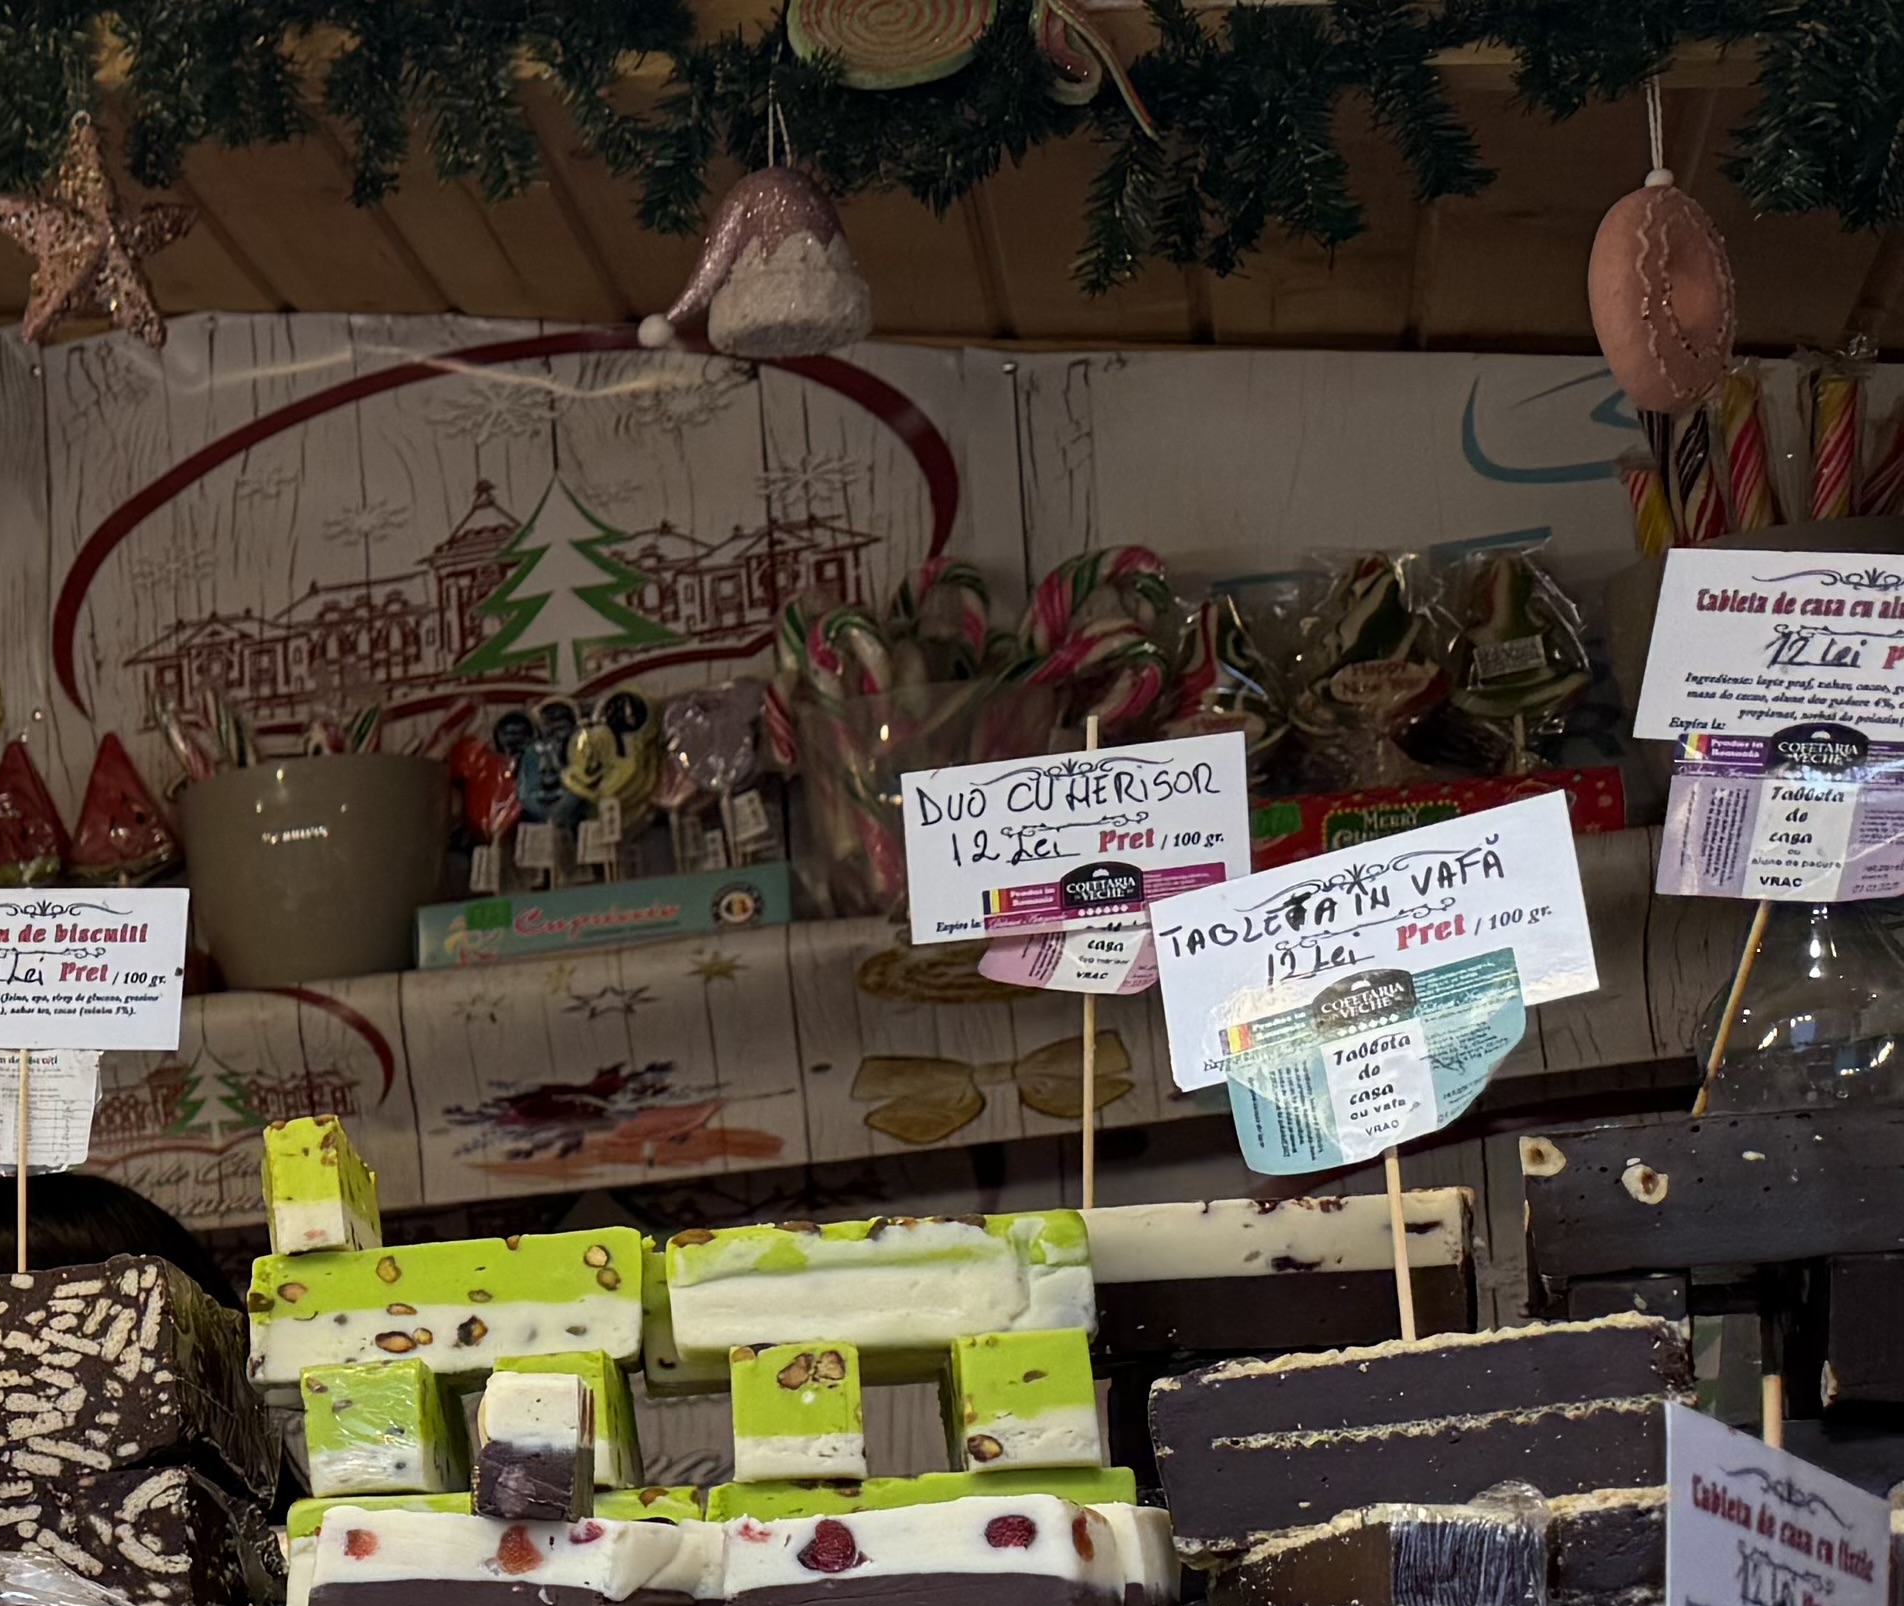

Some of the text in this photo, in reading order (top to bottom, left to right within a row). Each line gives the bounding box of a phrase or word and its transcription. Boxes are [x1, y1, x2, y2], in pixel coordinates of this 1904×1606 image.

[1697, 589, 1874, 618] Tableta de casa cu
[1778, 741, 1859, 755] COFETARIA
[1792, 751, 1843, 765] VECHE
[916, 787, 986, 826] DUO
[1007, 774, 1054, 812] CU
[1785, 808, 1808, 823] de
[952, 830, 1000, 866] 12
[1098, 828, 1154, 853] Pret
[1173, 832, 1200, 847] 100
[1769, 831, 1812, 844] casa
[1759, 876, 1803, 887] VRAC
[18, 924, 46, 943] de
[54, 923, 148, 943] biscuiti
[1396, 914, 1467, 951] Pret
[1488, 908, 1524, 932] 100
[59, 961, 109, 983] Pret
[123, 972, 147, 985] 100
[1321, 982, 1405, 1014] COFETARIA
[1339, 997, 1393, 1020] VECHE
[1358, 1063, 1381, 1081] de
[1350, 1083, 1395, 1106] casa
